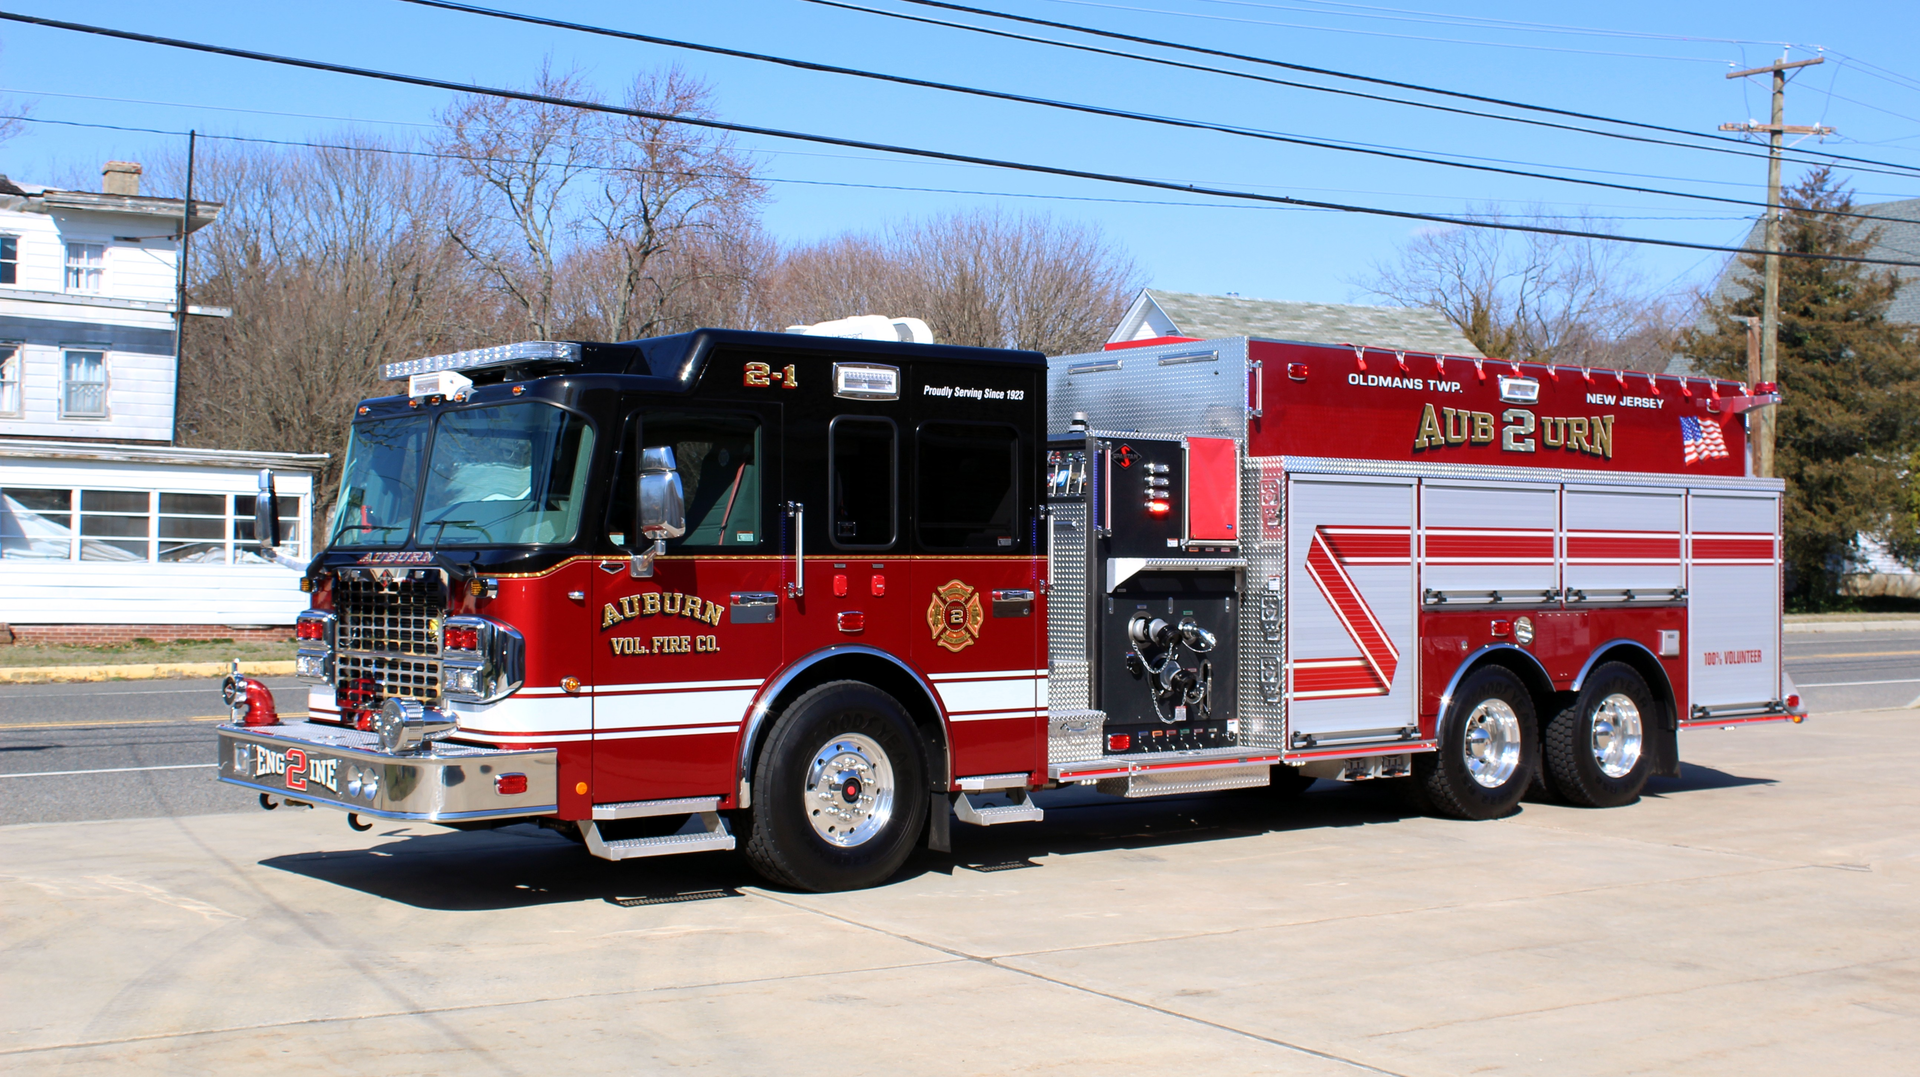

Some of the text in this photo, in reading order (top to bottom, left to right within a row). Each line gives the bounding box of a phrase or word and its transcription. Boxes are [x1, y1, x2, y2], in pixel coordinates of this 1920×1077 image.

[743, 361, 798, 389] 2-1
[1347, 373, 1463, 394] OLDMANS TWP.
[923, 385, 1025, 401] Proudly Serving Since 1923
[1586, 393, 1665, 409] NEW JERSEY
[356, 551, 435, 565] AUBURN
[601, 591, 725, 630] AUBURN
[950, 609, 964, 624] 2
[610, 634, 720, 655] VOL. FIRE CO.
[1704, 649, 1762, 666] 100% VOLUNTEER
